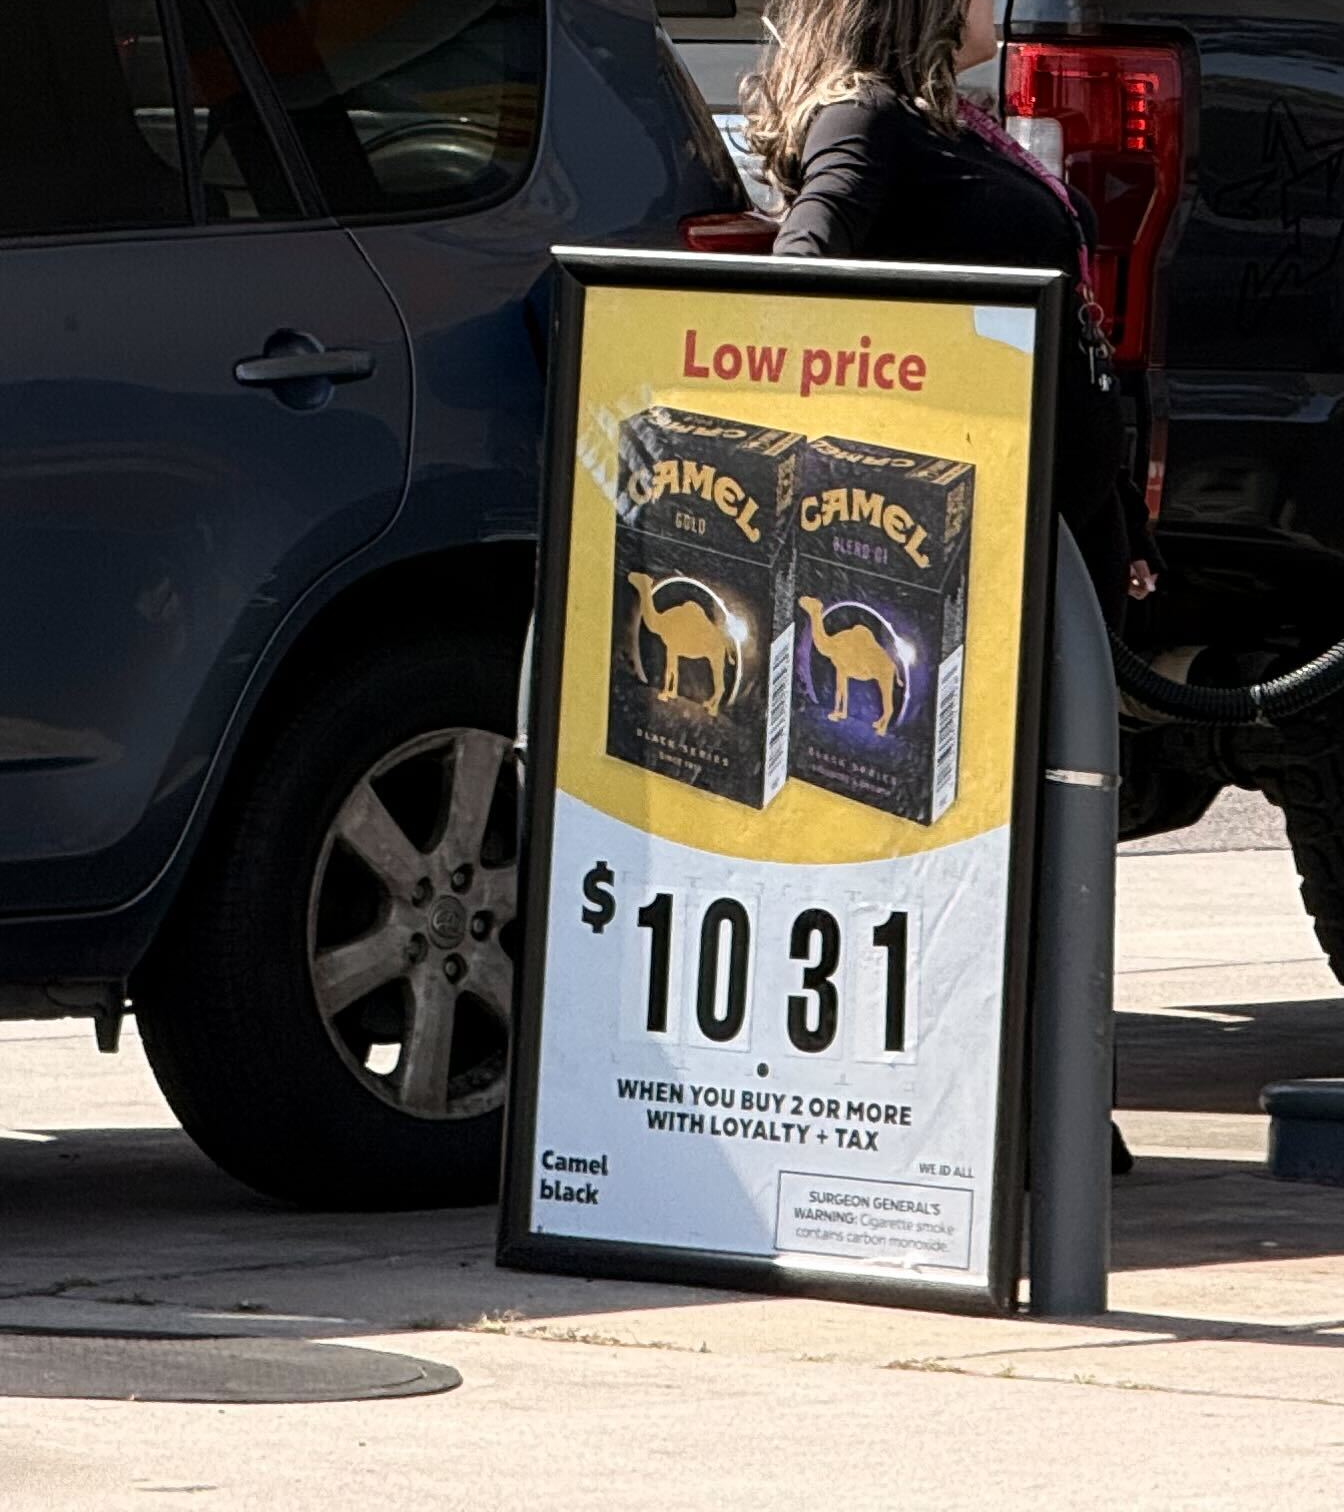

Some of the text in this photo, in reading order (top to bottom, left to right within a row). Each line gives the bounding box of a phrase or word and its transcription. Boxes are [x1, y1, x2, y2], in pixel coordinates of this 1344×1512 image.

[684, 329, 927, 396] Low price
[628, 460, 762, 543] CAMEL
[674, 511, 707, 536] GOLD
[800, 487, 931, 569] CAMEL
[616, 1078, 912, 1126] WHEN YOU BUY 2 OR MORE
[647, 1109, 879, 1152] WITH LOYALTY + TAX
[541, 1149, 609, 1176] Camel
[919, 1163, 975, 1179] WE ID ALL
[539, 1178, 599, 1205] black
[809, 1190, 941, 1216] SURGEON GENERAL'S
[794, 1207, 956, 1236] WARNING: Cigarette smoke
[795, 1226, 843, 1242] contains
[846, 1231, 886, 1246] carbon
